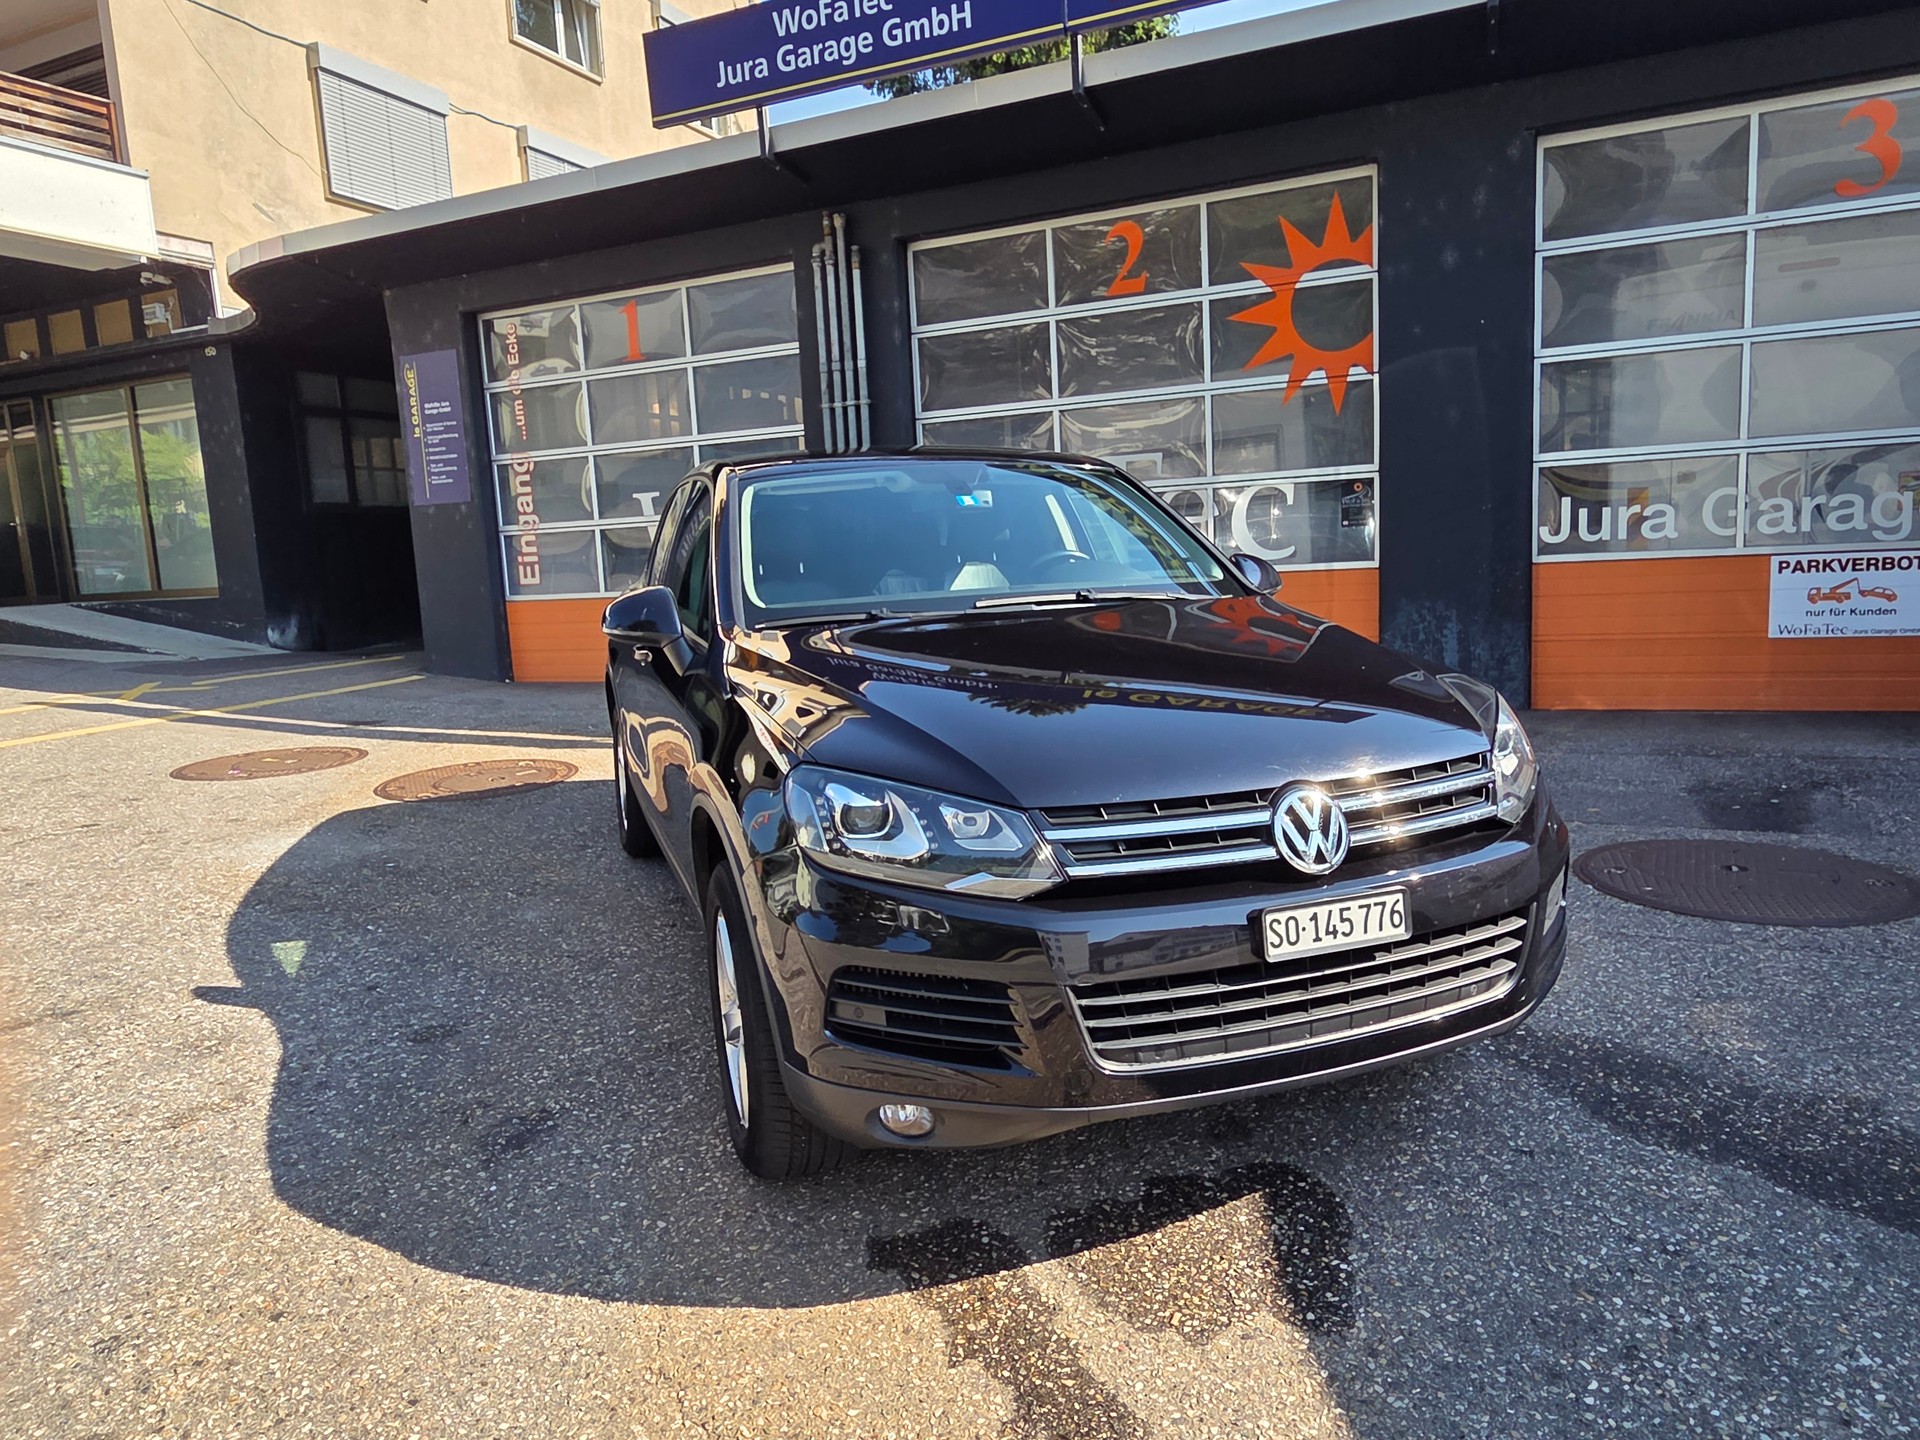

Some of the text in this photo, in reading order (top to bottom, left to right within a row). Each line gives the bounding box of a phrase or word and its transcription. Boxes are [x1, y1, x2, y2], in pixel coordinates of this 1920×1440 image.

[716, 0, 972, 88] Jura Garage GmbH
[1833, 97, 1903, 198] 3
[1105, 220, 1149, 296] 2
[505, 321, 520, 366] Ecke
[616, 299, 648, 362] 1
[405, 368, 420, 425] GARAGE
[511, 452, 541, 586] Eingang
[1539, 486, 1918, 544] Jura Garag
[1777, 623, 1849, 636] WoFaTec
[1805, 606, 1897, 617] nur für Kunden
